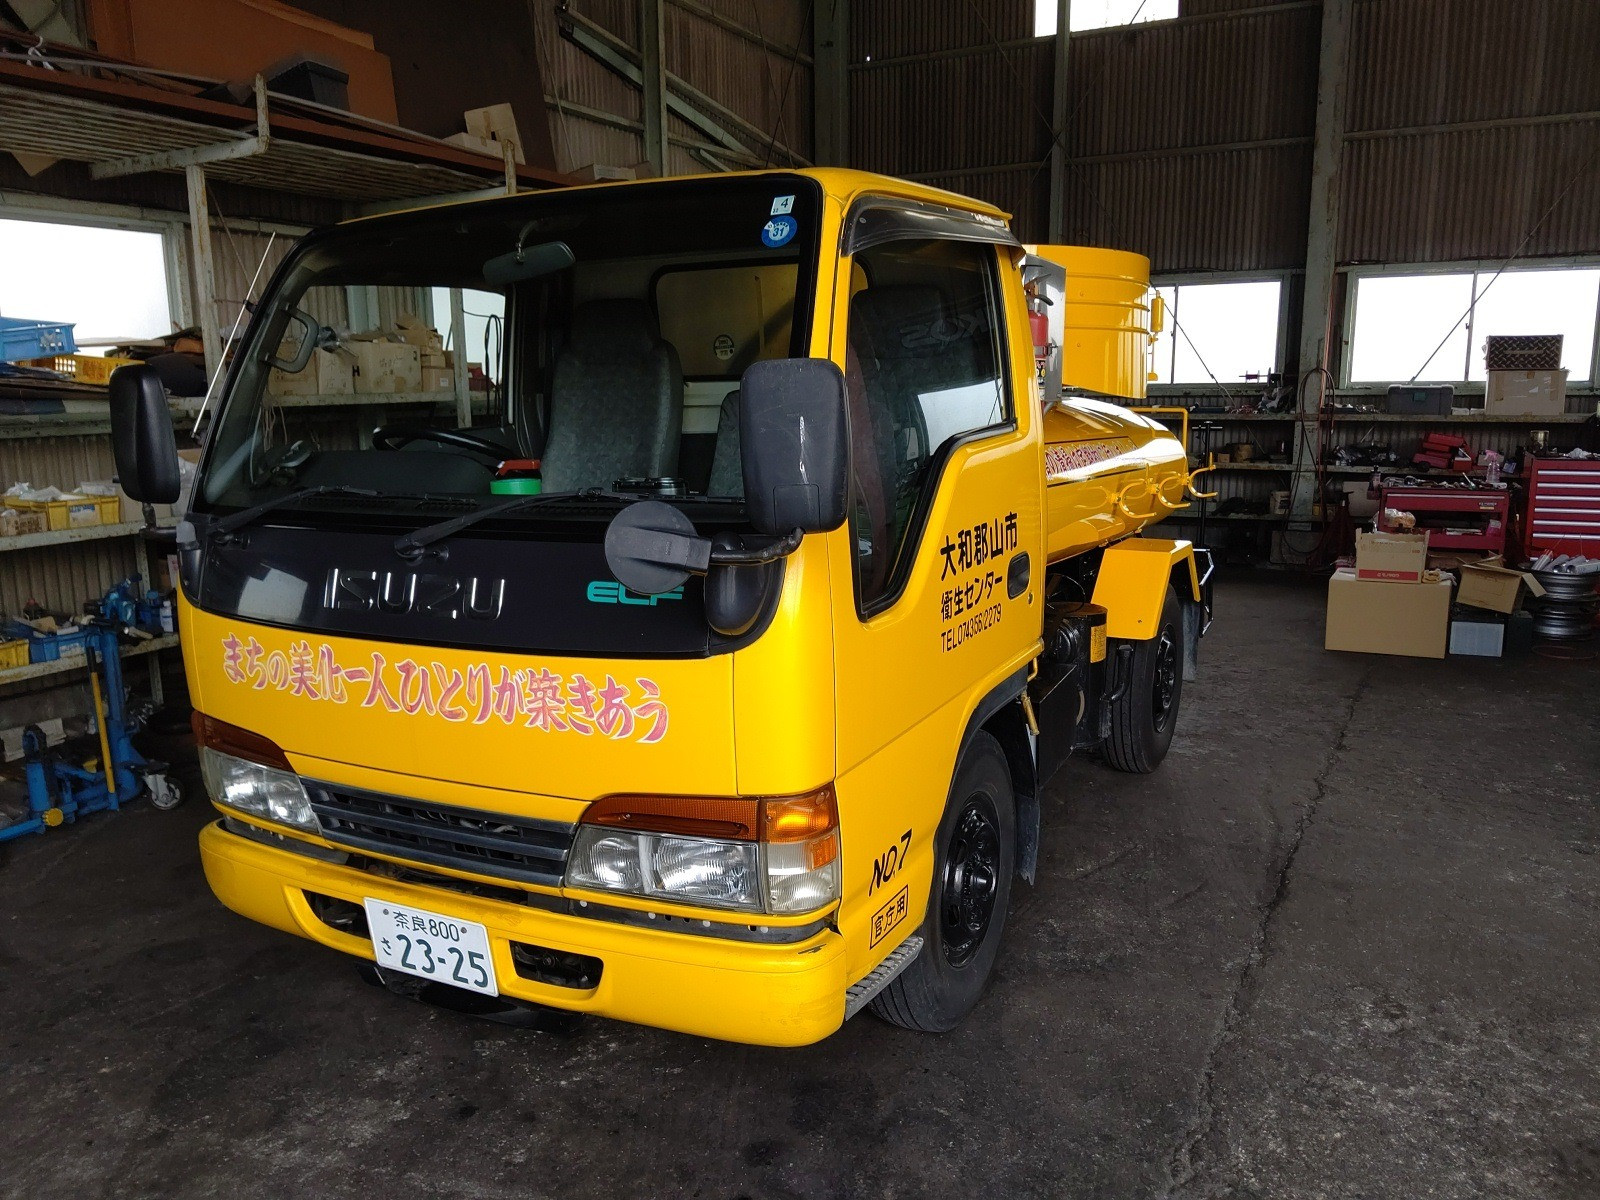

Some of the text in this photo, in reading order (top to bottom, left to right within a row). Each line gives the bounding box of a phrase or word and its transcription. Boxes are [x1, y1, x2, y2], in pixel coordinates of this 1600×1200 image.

[781, 198, 789, 208] 4
[772, 227, 785, 237] 31
[940, 511, 1018, 581] 大和郡山市
[323, 568, 505, 621] ISUZU
[941, 571, 1003, 623] 衛生センター
[222, 632, 669, 744] まちの美化一人ひとりが築きあう
[874, 893, 906, 940] 官庁用
[381, 934, 489, 988] さ 23-25
